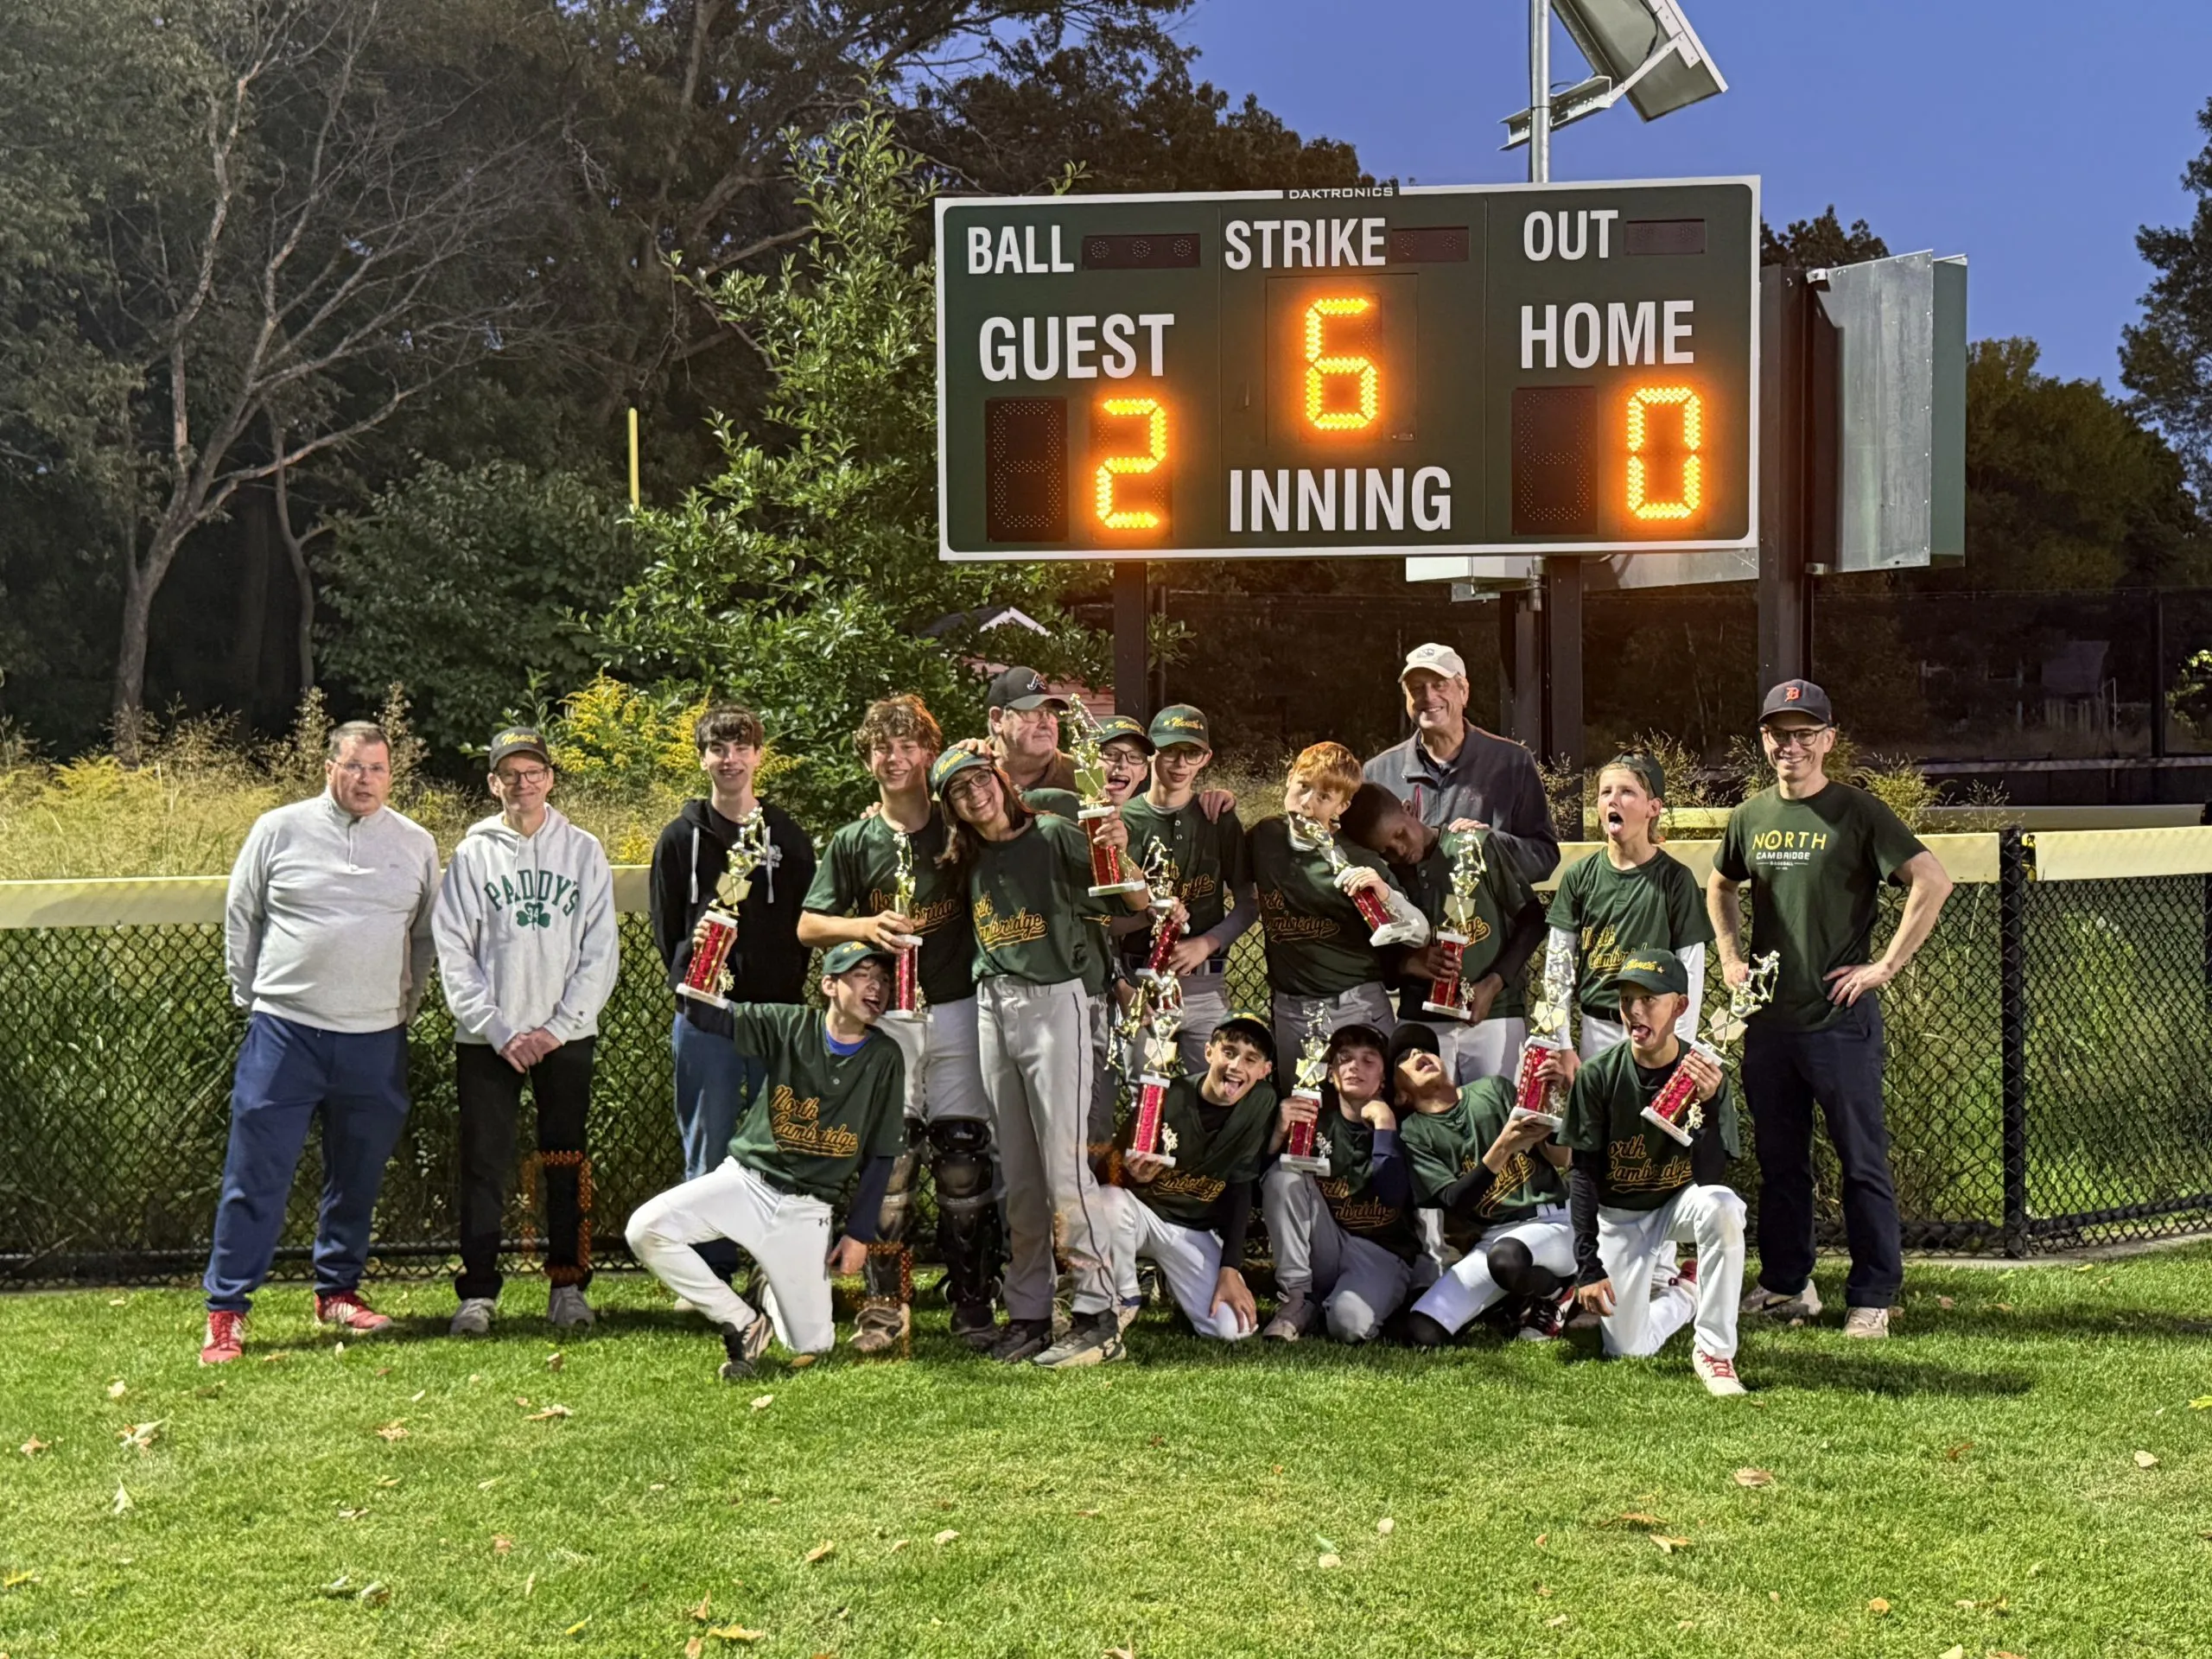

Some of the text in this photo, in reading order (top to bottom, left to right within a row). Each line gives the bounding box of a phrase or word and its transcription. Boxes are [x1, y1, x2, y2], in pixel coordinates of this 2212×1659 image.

[1288, 187, 1394, 200] DAKTRONICS
[968, 225, 1075, 275] BALL
[1224, 218, 1386, 270] STRIKE
[1523, 209, 1618, 262] OUT
[979, 313, 1175, 382] GUEST
[1521, 300, 1694, 369] HOME
[1304, 296, 1380, 431] 6
[1094, 397, 1168, 530] 2
[1625, 385, 1702, 521] 0
[1230, 466, 1452, 532] INNING
[1751, 830, 1827, 850] NORTH
[1756, 851, 1811, 861] CAMBRIDGE
[484, 869, 580, 917] PADDY'S
[770, 1084, 820, 1121] North
[772, 1111, 859, 1155] Cambridge
[1607, 1133, 1647, 1160] orth
